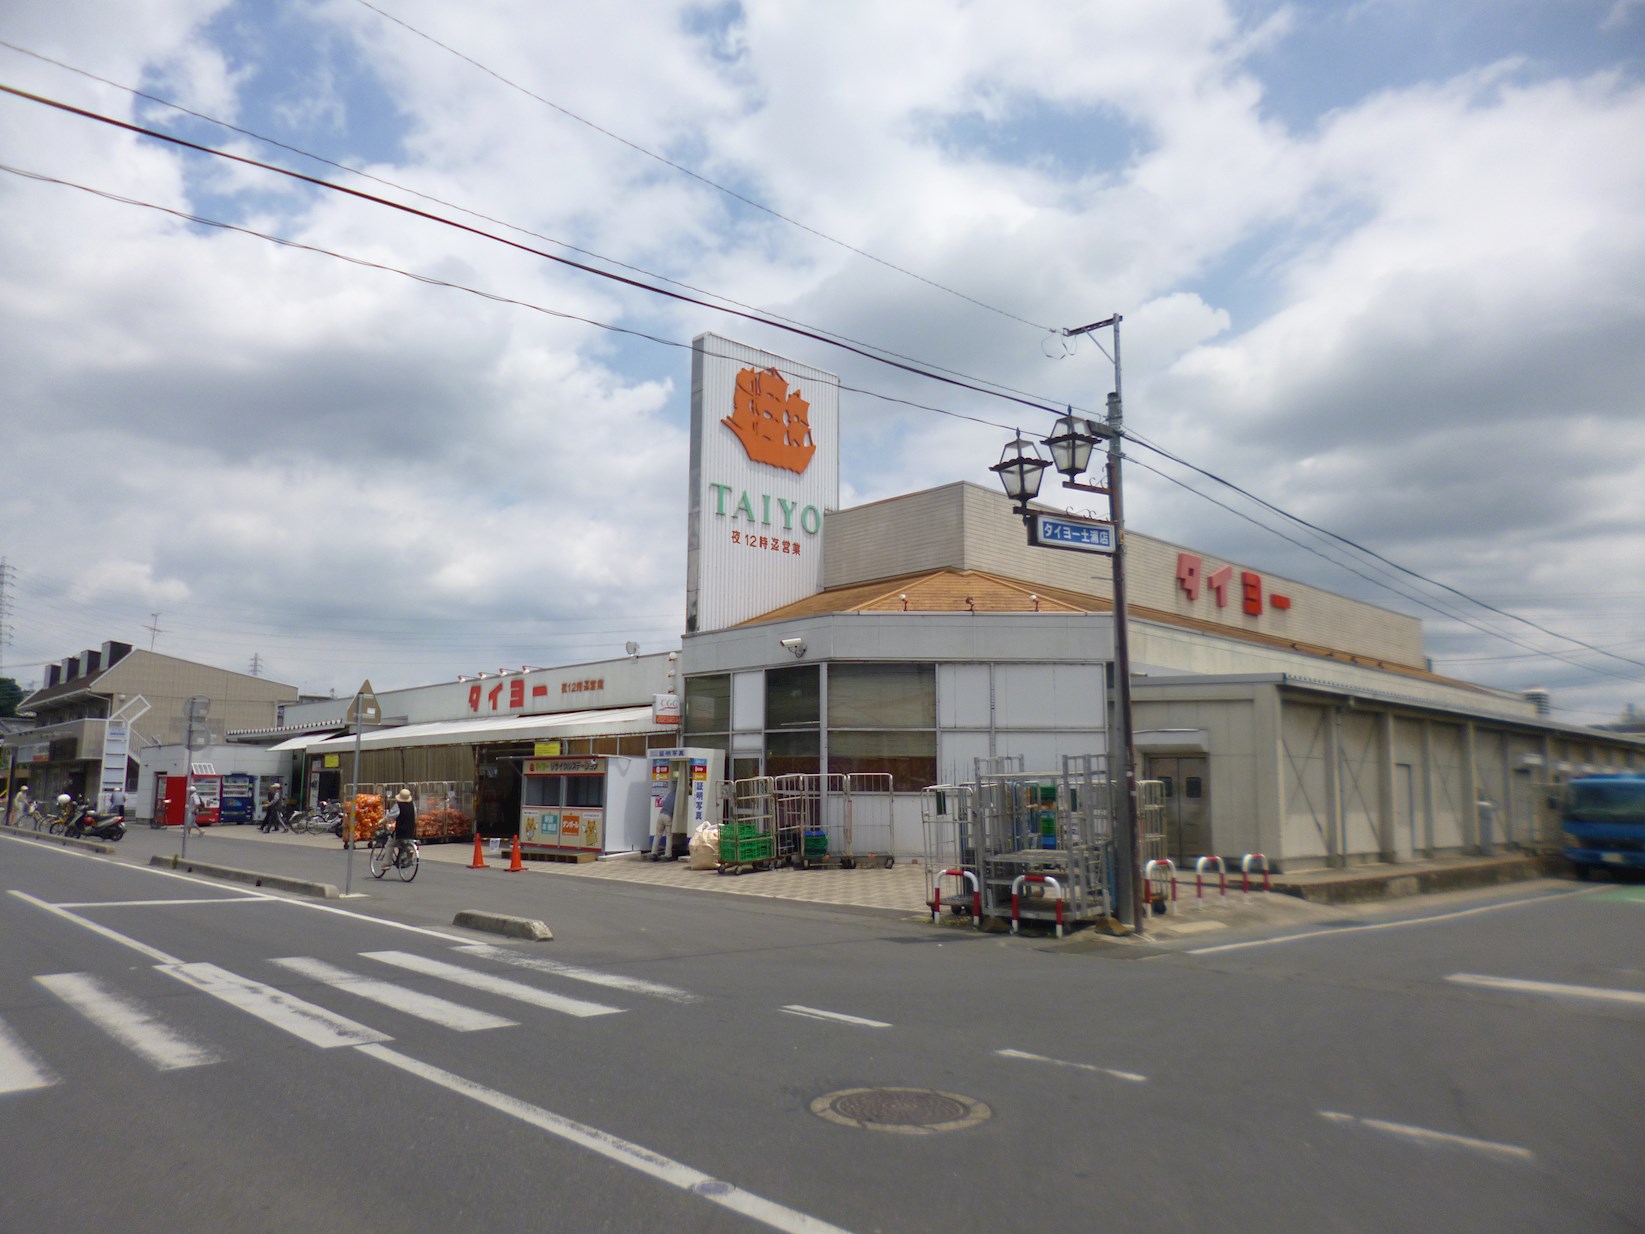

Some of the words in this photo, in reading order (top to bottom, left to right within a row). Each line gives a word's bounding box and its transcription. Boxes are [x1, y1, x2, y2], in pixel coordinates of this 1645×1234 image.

[709, 482, 821, 535] TAIYO
[731, 530, 801, 556] 夜12時迄営業
[1044, 523, 1109, 545] タイヨー土浦店
[1176, 552, 1291, 616] タイヨー
[468, 679, 548, 712] タイヨー
[695, 781, 704, 820] 証明写真
